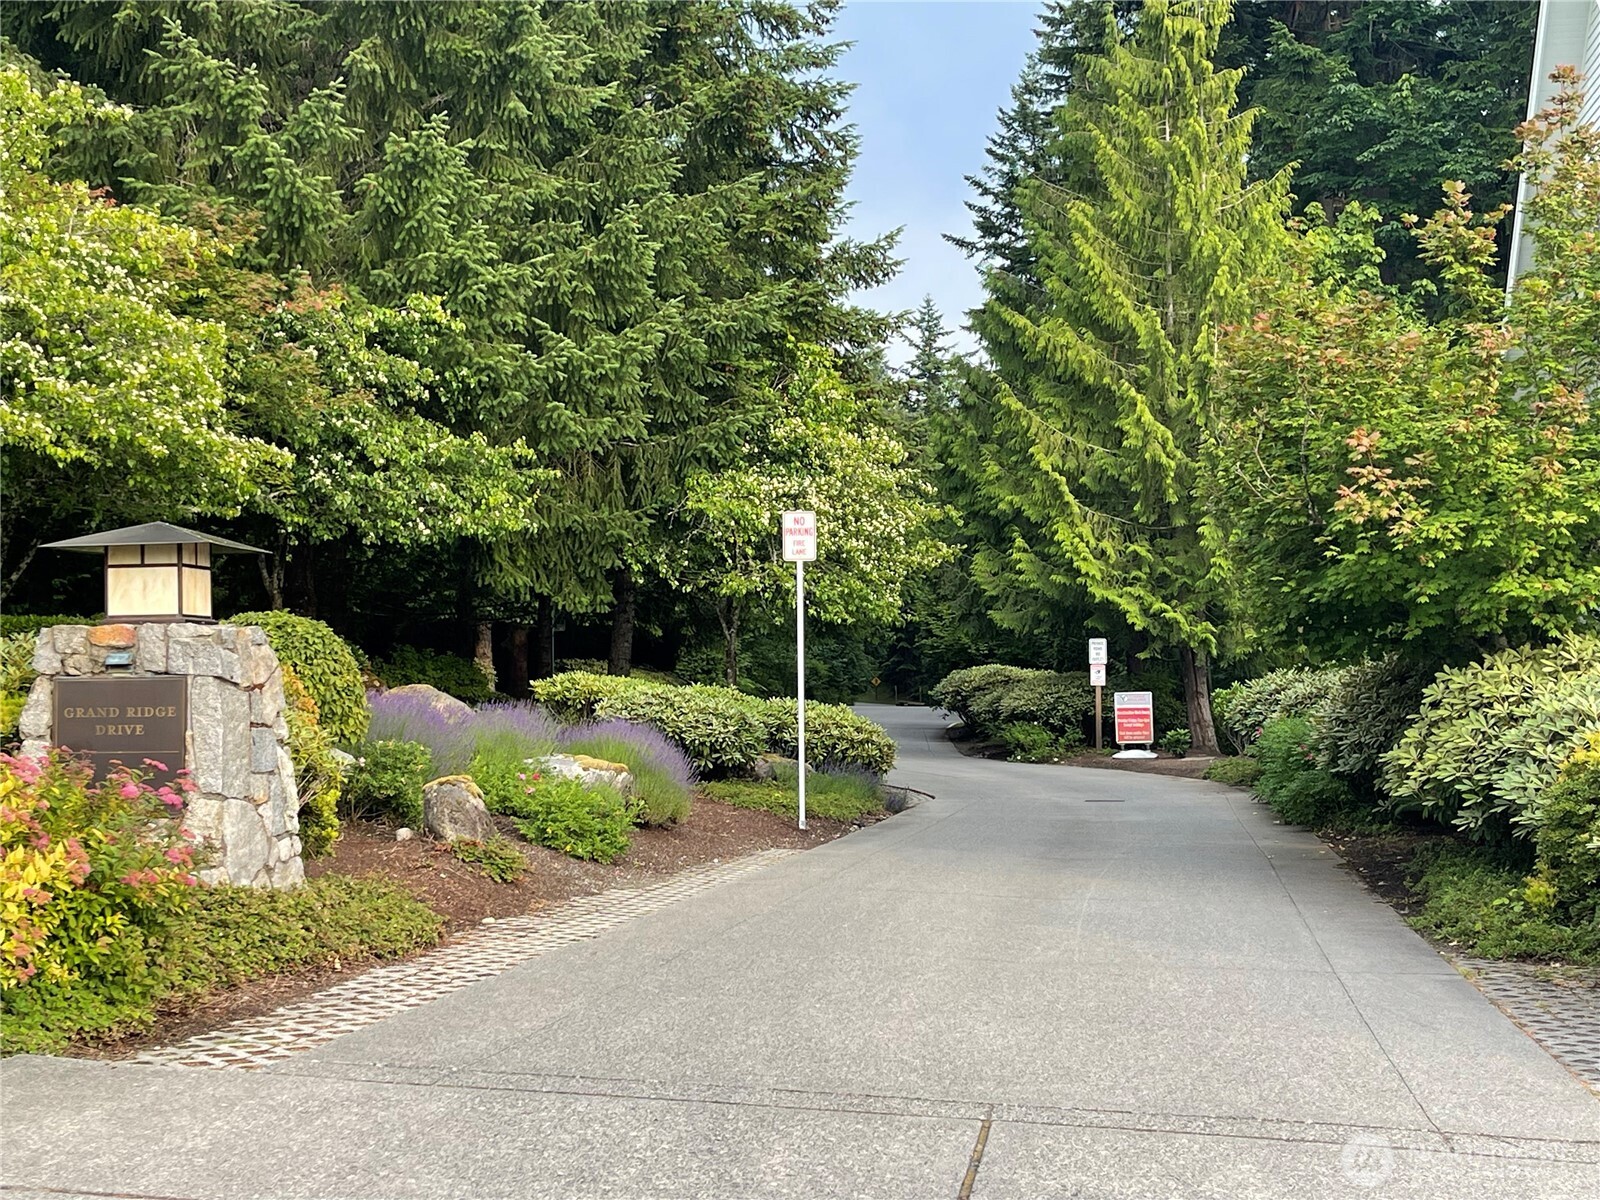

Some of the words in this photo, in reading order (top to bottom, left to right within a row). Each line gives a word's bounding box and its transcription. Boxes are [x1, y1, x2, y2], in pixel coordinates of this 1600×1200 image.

[793, 516, 805, 526] NO
[785, 528, 813, 536] PARKING
[64, 707, 120, 718] GRAND
[126, 706, 177, 718] RIDGE
[95, 724, 145, 736] DRIVE
